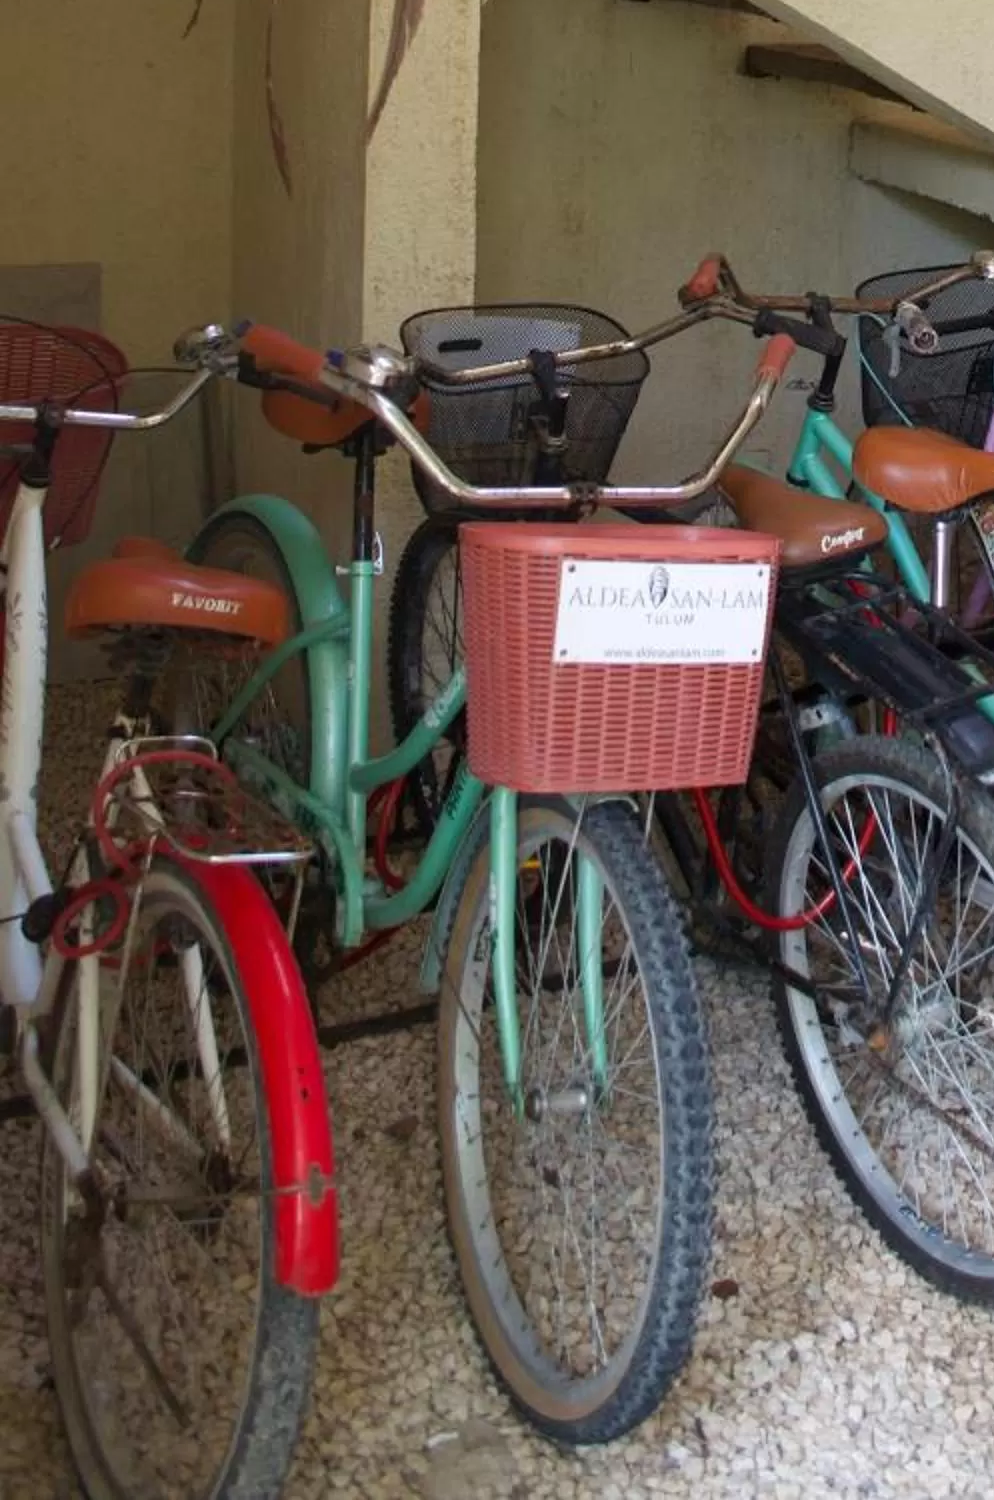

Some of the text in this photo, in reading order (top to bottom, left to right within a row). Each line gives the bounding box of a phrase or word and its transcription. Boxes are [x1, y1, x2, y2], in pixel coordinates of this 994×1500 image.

[172, 591, 243, 615] FAVORIT
[568, 586, 764, 611] ALDEA SAN-LAM
[644, 612, 696, 627] TULUM
